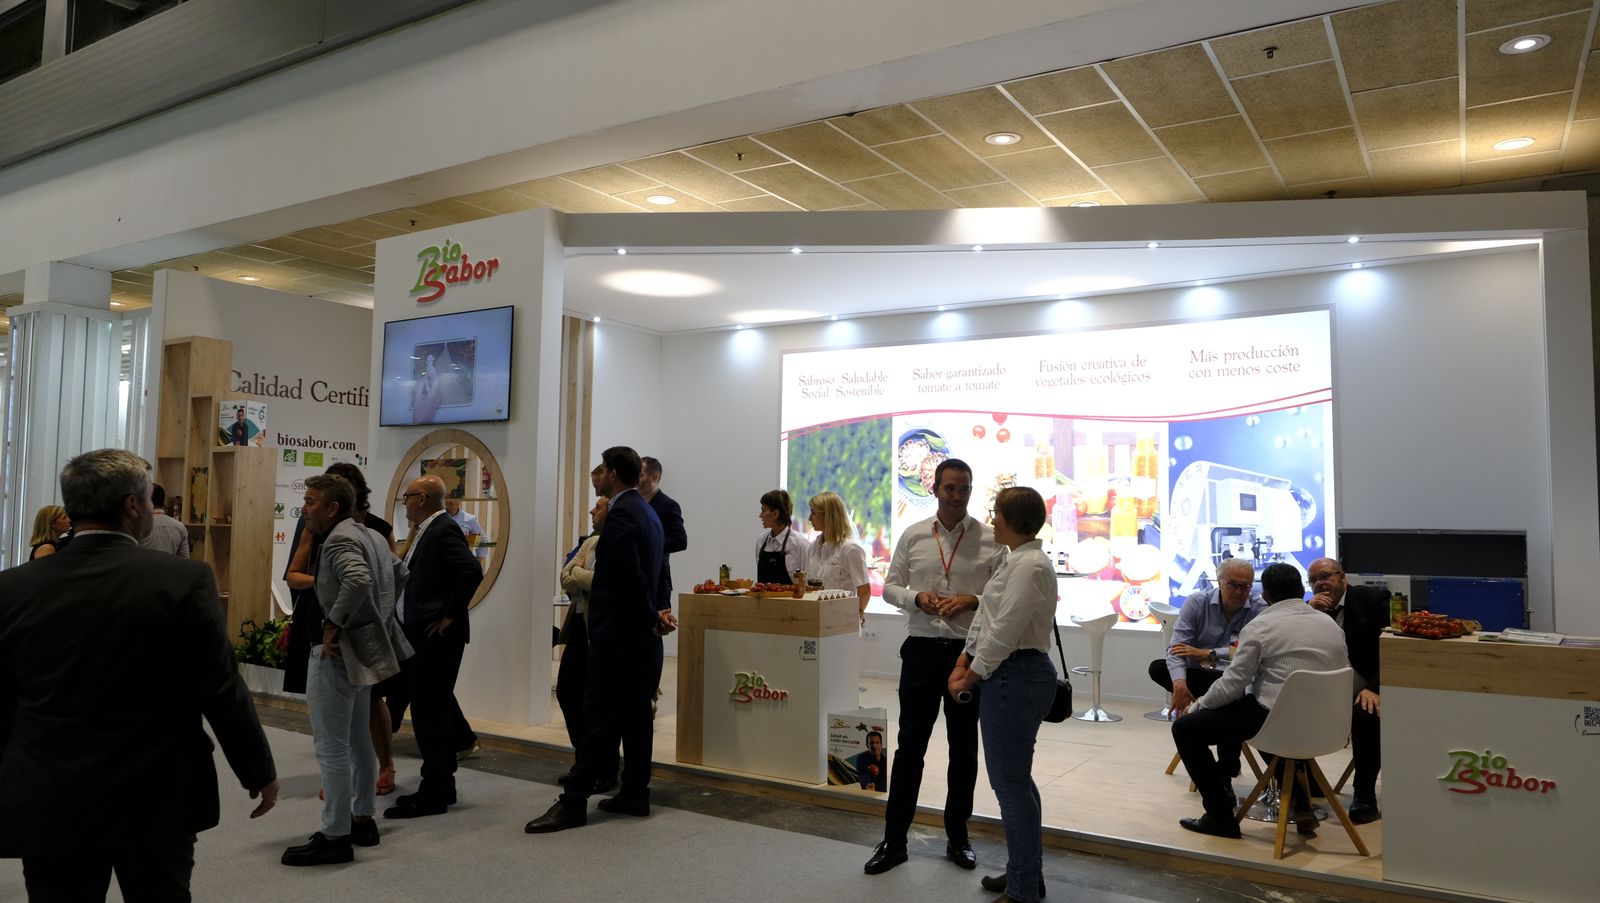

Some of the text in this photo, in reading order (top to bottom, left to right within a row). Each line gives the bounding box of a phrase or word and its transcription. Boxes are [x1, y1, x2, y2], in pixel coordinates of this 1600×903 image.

[409, 239, 461, 293] Bio
[416, 254, 499, 303] Sabor
[1039, 353, 1147, 373] Fusión creativa de
[1190, 345, 1300, 364] Más producción
[798, 370, 888, 388] Sabroso Saludable
[912, 363, 1008, 381] Sabor garantizado
[1035, 369, 1152, 388] vegetales ecológicos
[1189, 362, 1301, 379] con menos coste
[801, 383, 885, 399] Social Sostenible
[918, 380, 1000, 394] tomate a tomate
[277, 432, 356, 451] biosabor.com
[729, 672, 764, 695] Bio
[734, 684, 787, 704] Sabor
[1438, 750, 1508, 782] Bio
[1448, 768, 1556, 795] Sabor
